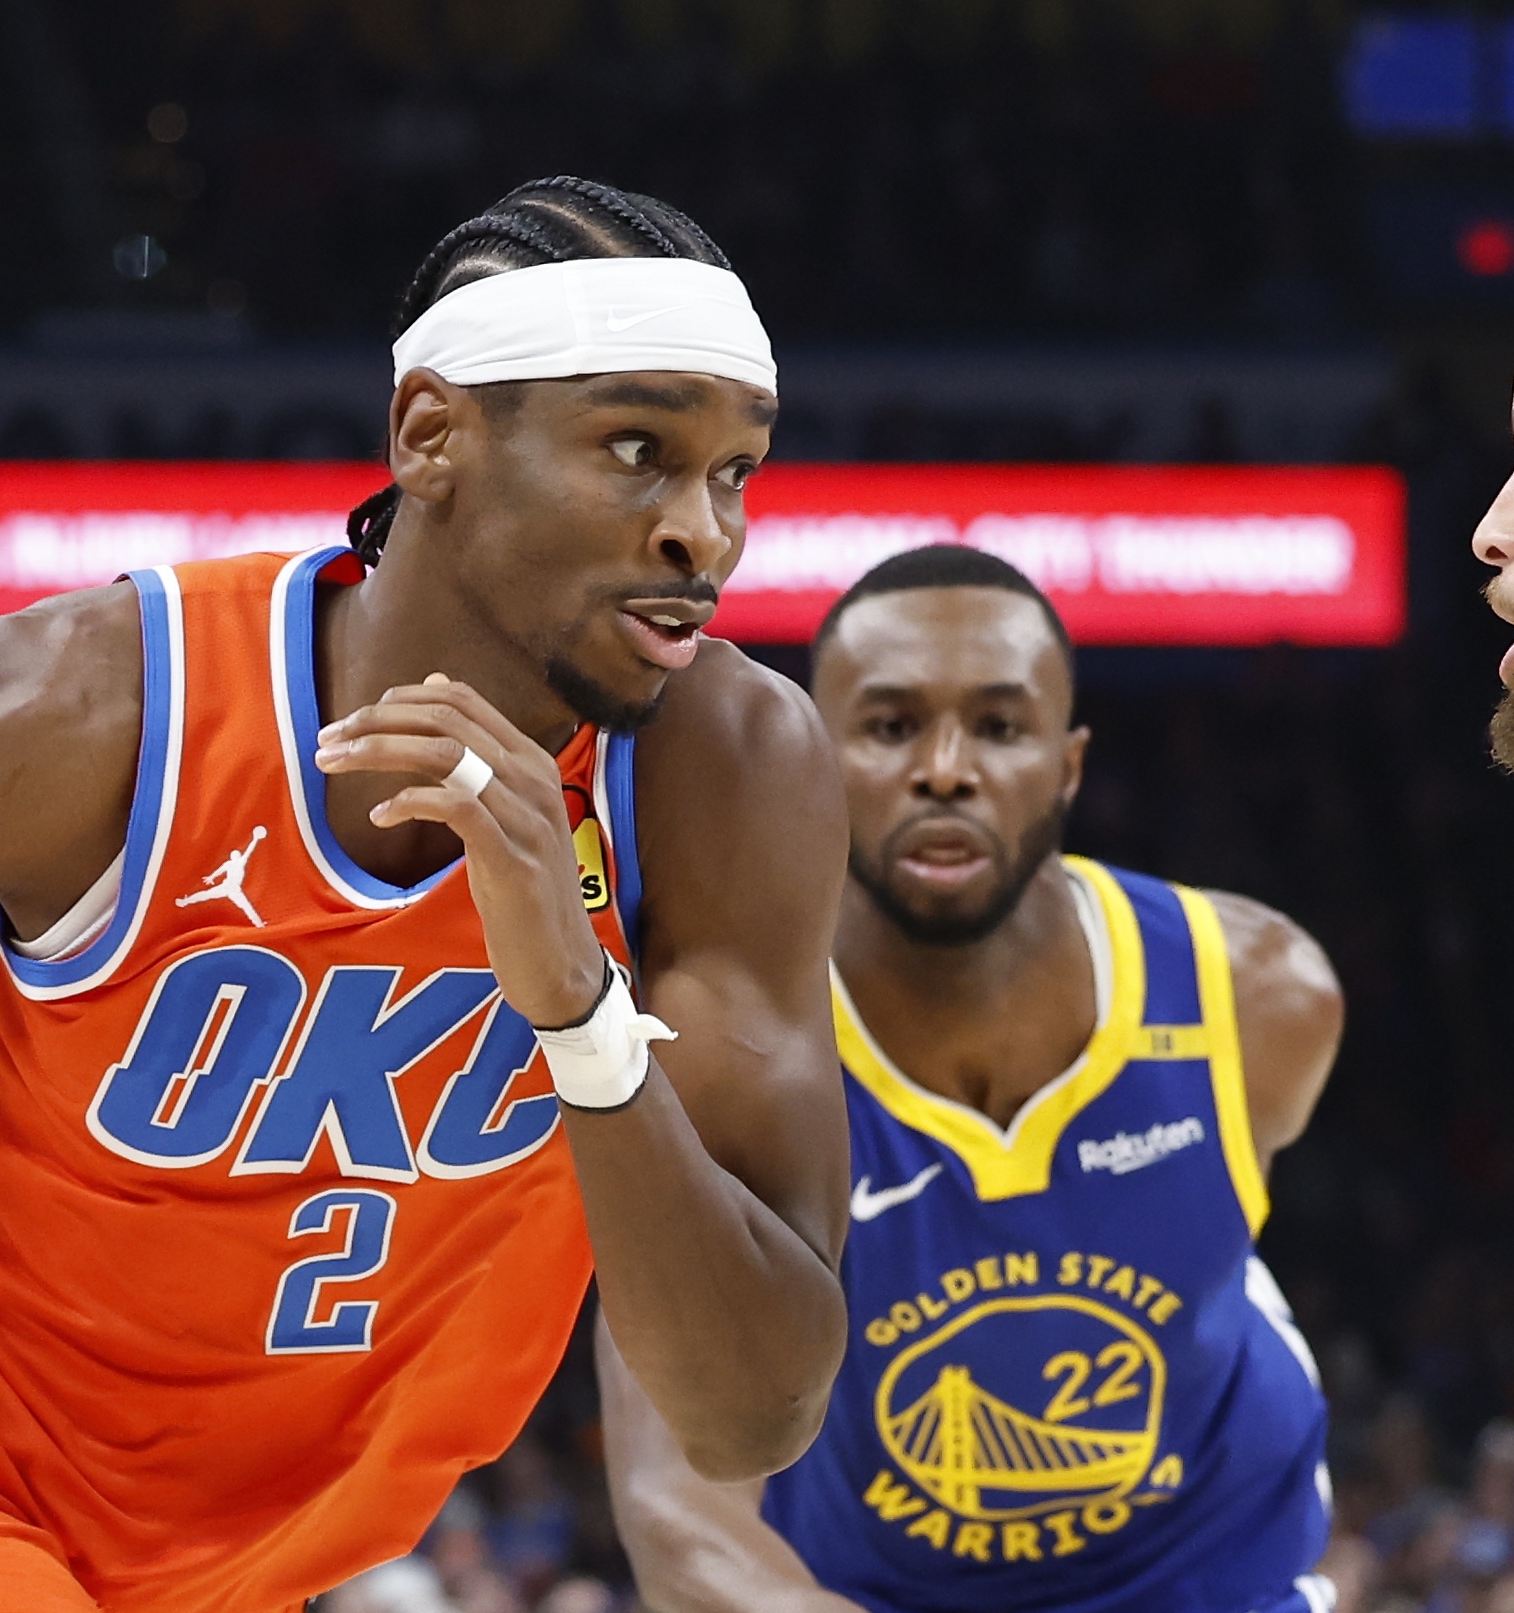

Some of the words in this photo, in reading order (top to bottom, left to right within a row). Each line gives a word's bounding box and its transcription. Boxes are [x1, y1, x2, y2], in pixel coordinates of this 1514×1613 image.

[1077, 1116, 1205, 1175] Rakuten
[265, 1188, 397, 1355] 2
[865, 1252, 1041, 1347] GOLDEN
[1057, 1251, 1186, 1327] STATE
[1042, 1340, 1146, 1422] 22
